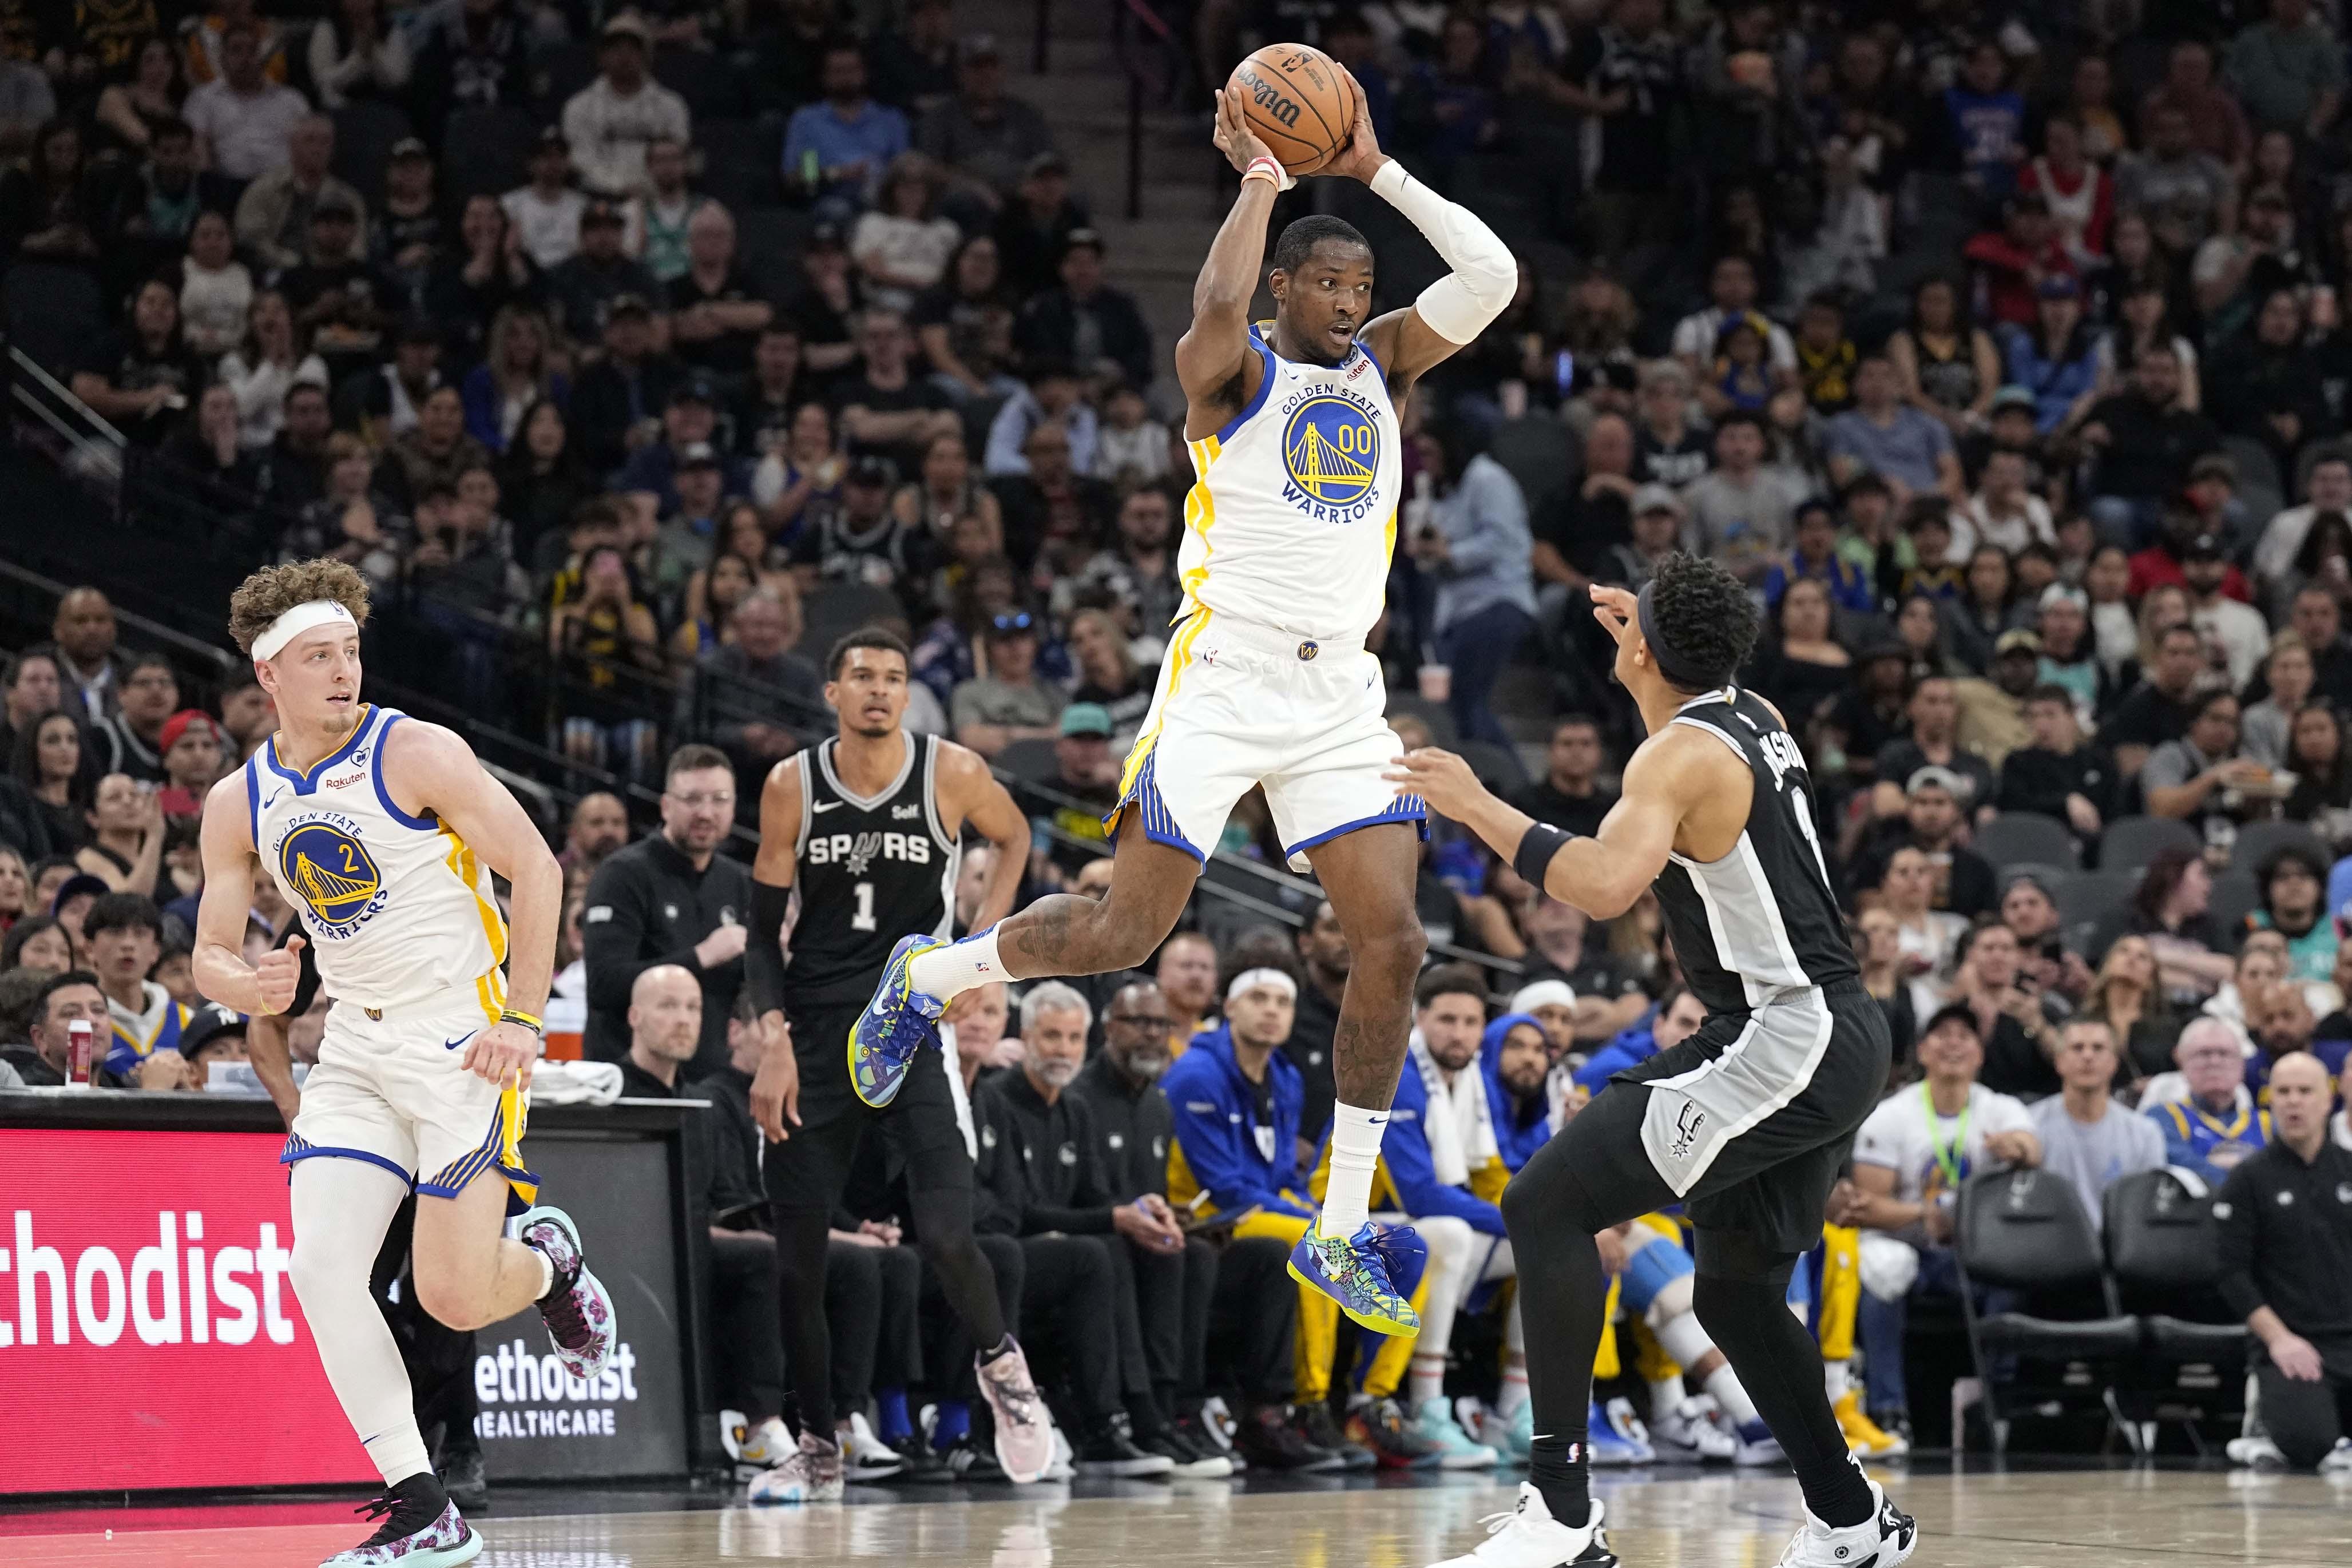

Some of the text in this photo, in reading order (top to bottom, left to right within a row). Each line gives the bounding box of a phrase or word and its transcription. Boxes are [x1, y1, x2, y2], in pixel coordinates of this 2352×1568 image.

[1282, 383, 1381, 419] GOLDEN STATE
[1338, 424, 1371, 455] 00
[1282, 480, 1379, 524] WARRIORS
[326, 771, 366, 789] Rakuten
[325, 812, 363, 839] STATE
[338, 844, 360, 873] 2
[808, 832, 930, 875] SPURS
[305, 890, 388, 940] WARRIORS
[851, 881, 876, 932] 1
